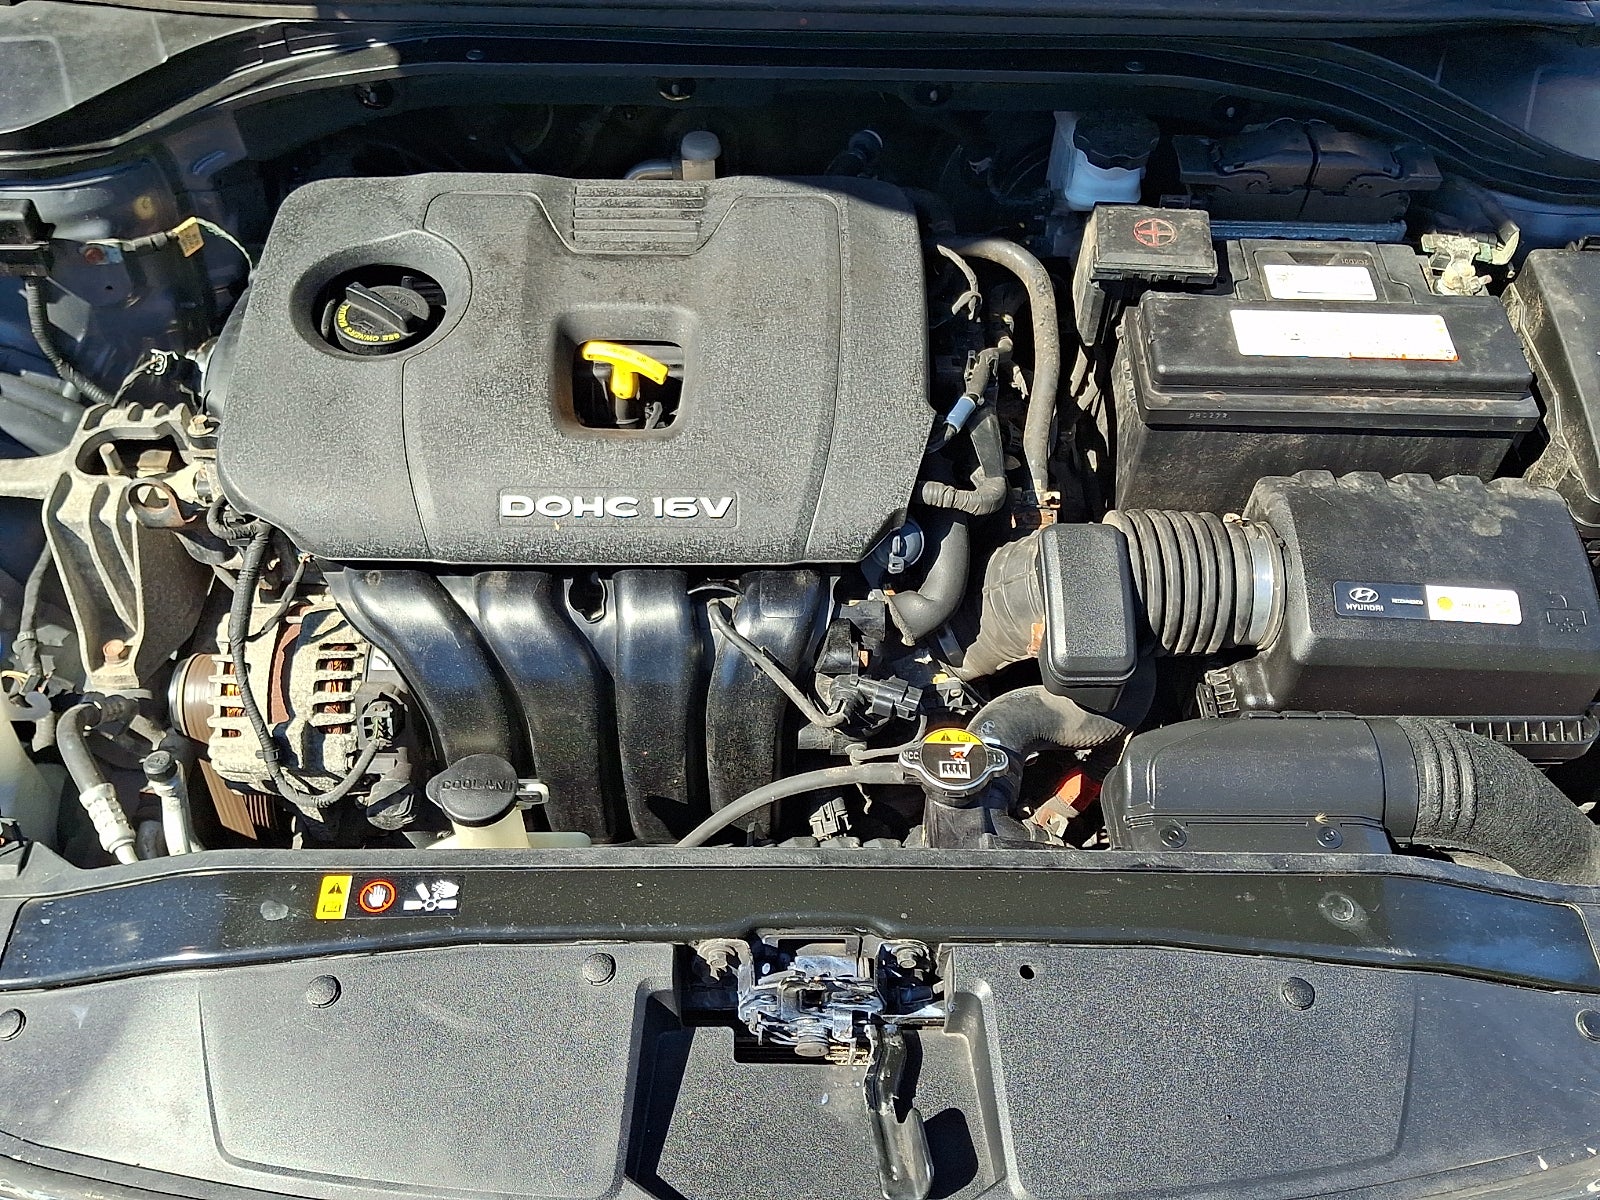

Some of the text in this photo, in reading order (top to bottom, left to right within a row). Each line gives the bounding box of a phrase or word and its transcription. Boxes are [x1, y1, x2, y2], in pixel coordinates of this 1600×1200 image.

[382, 332, 401, 342] SEE
[501, 494, 734, 519] DOHC 16V
[1345, 602, 1385, 612] HYUNDAI
[441, 779, 516, 791] COOLANT
